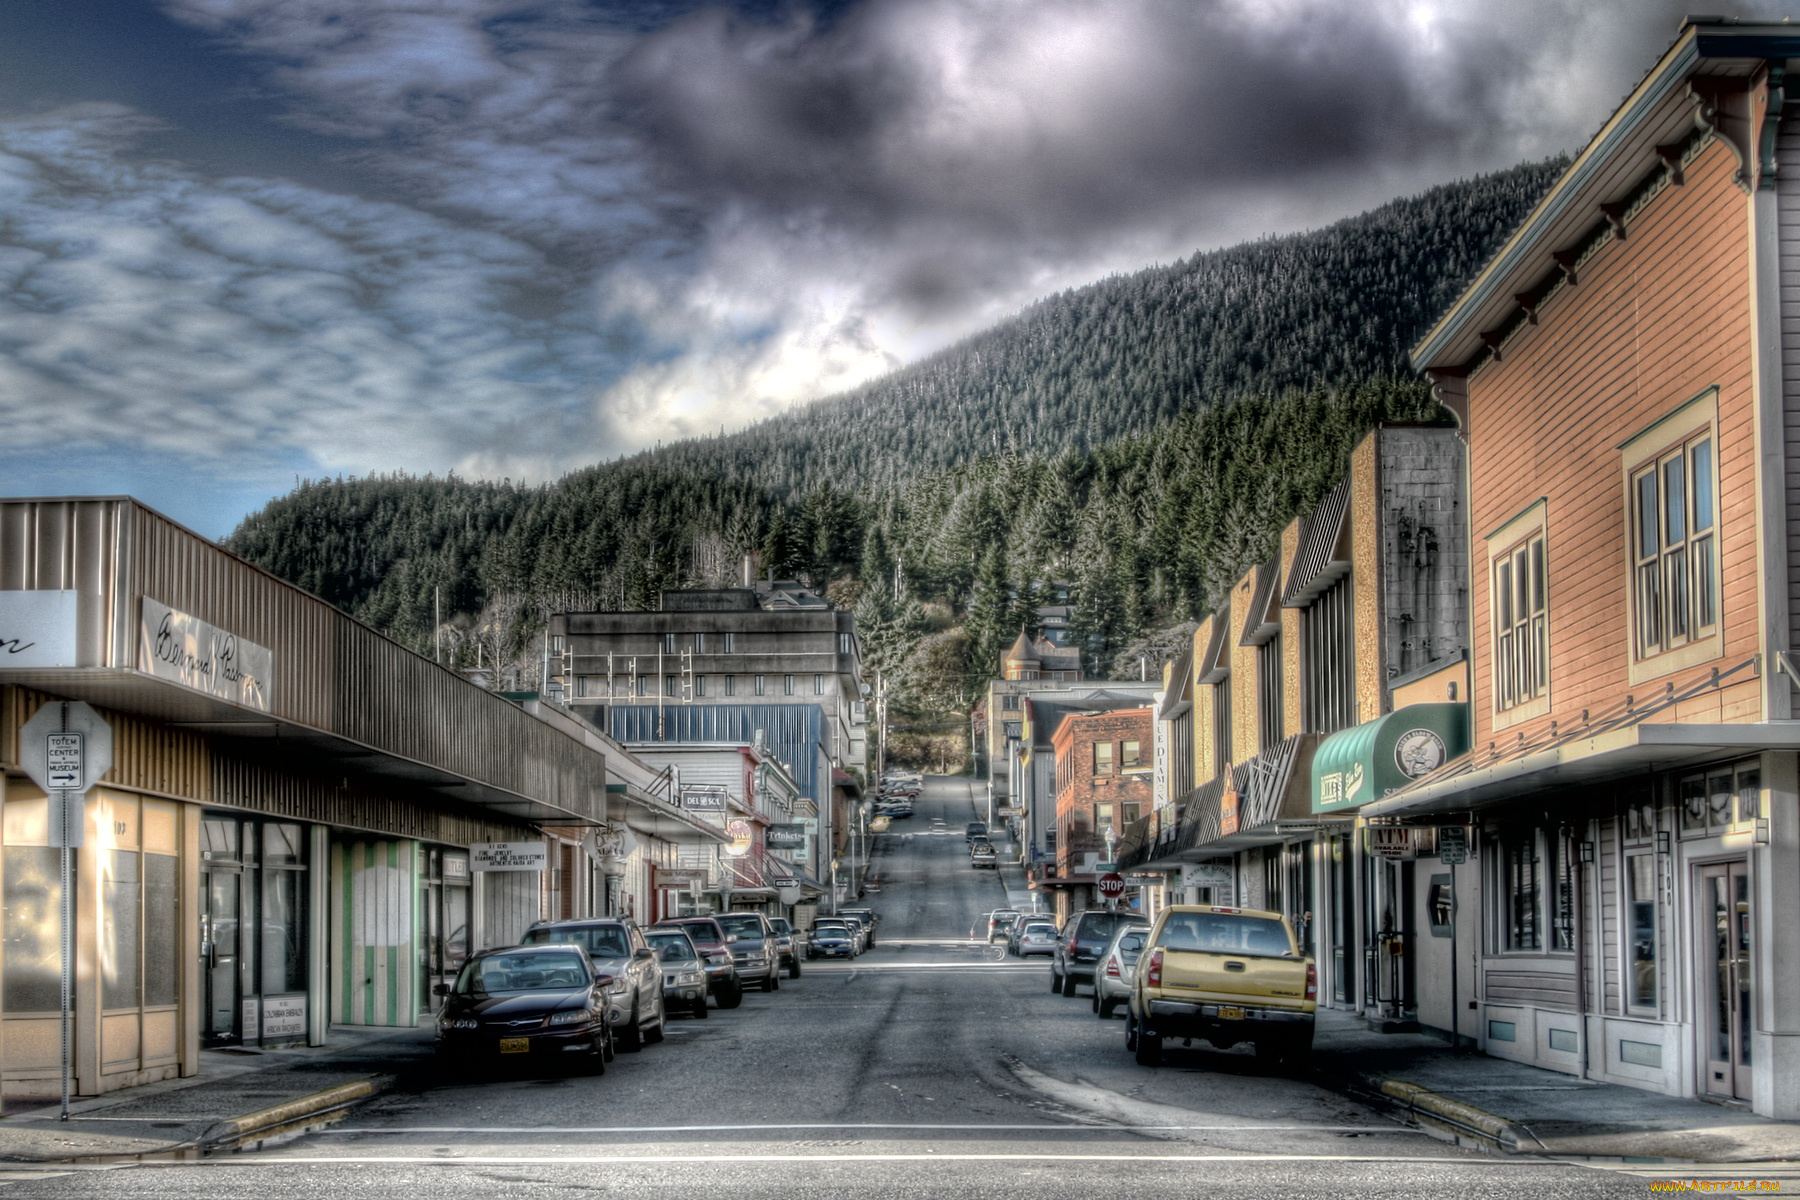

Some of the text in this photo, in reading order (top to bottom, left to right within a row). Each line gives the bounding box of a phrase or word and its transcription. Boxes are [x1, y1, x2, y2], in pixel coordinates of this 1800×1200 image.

[687, 797, 700, 805] DEL
[769, 831, 803, 840] Trinkets
[1375, 828, 1409, 844] ATM
[1187, 865, 1233, 880] CEDAR CHEST
[1100, 880, 1124, 891] STOP
